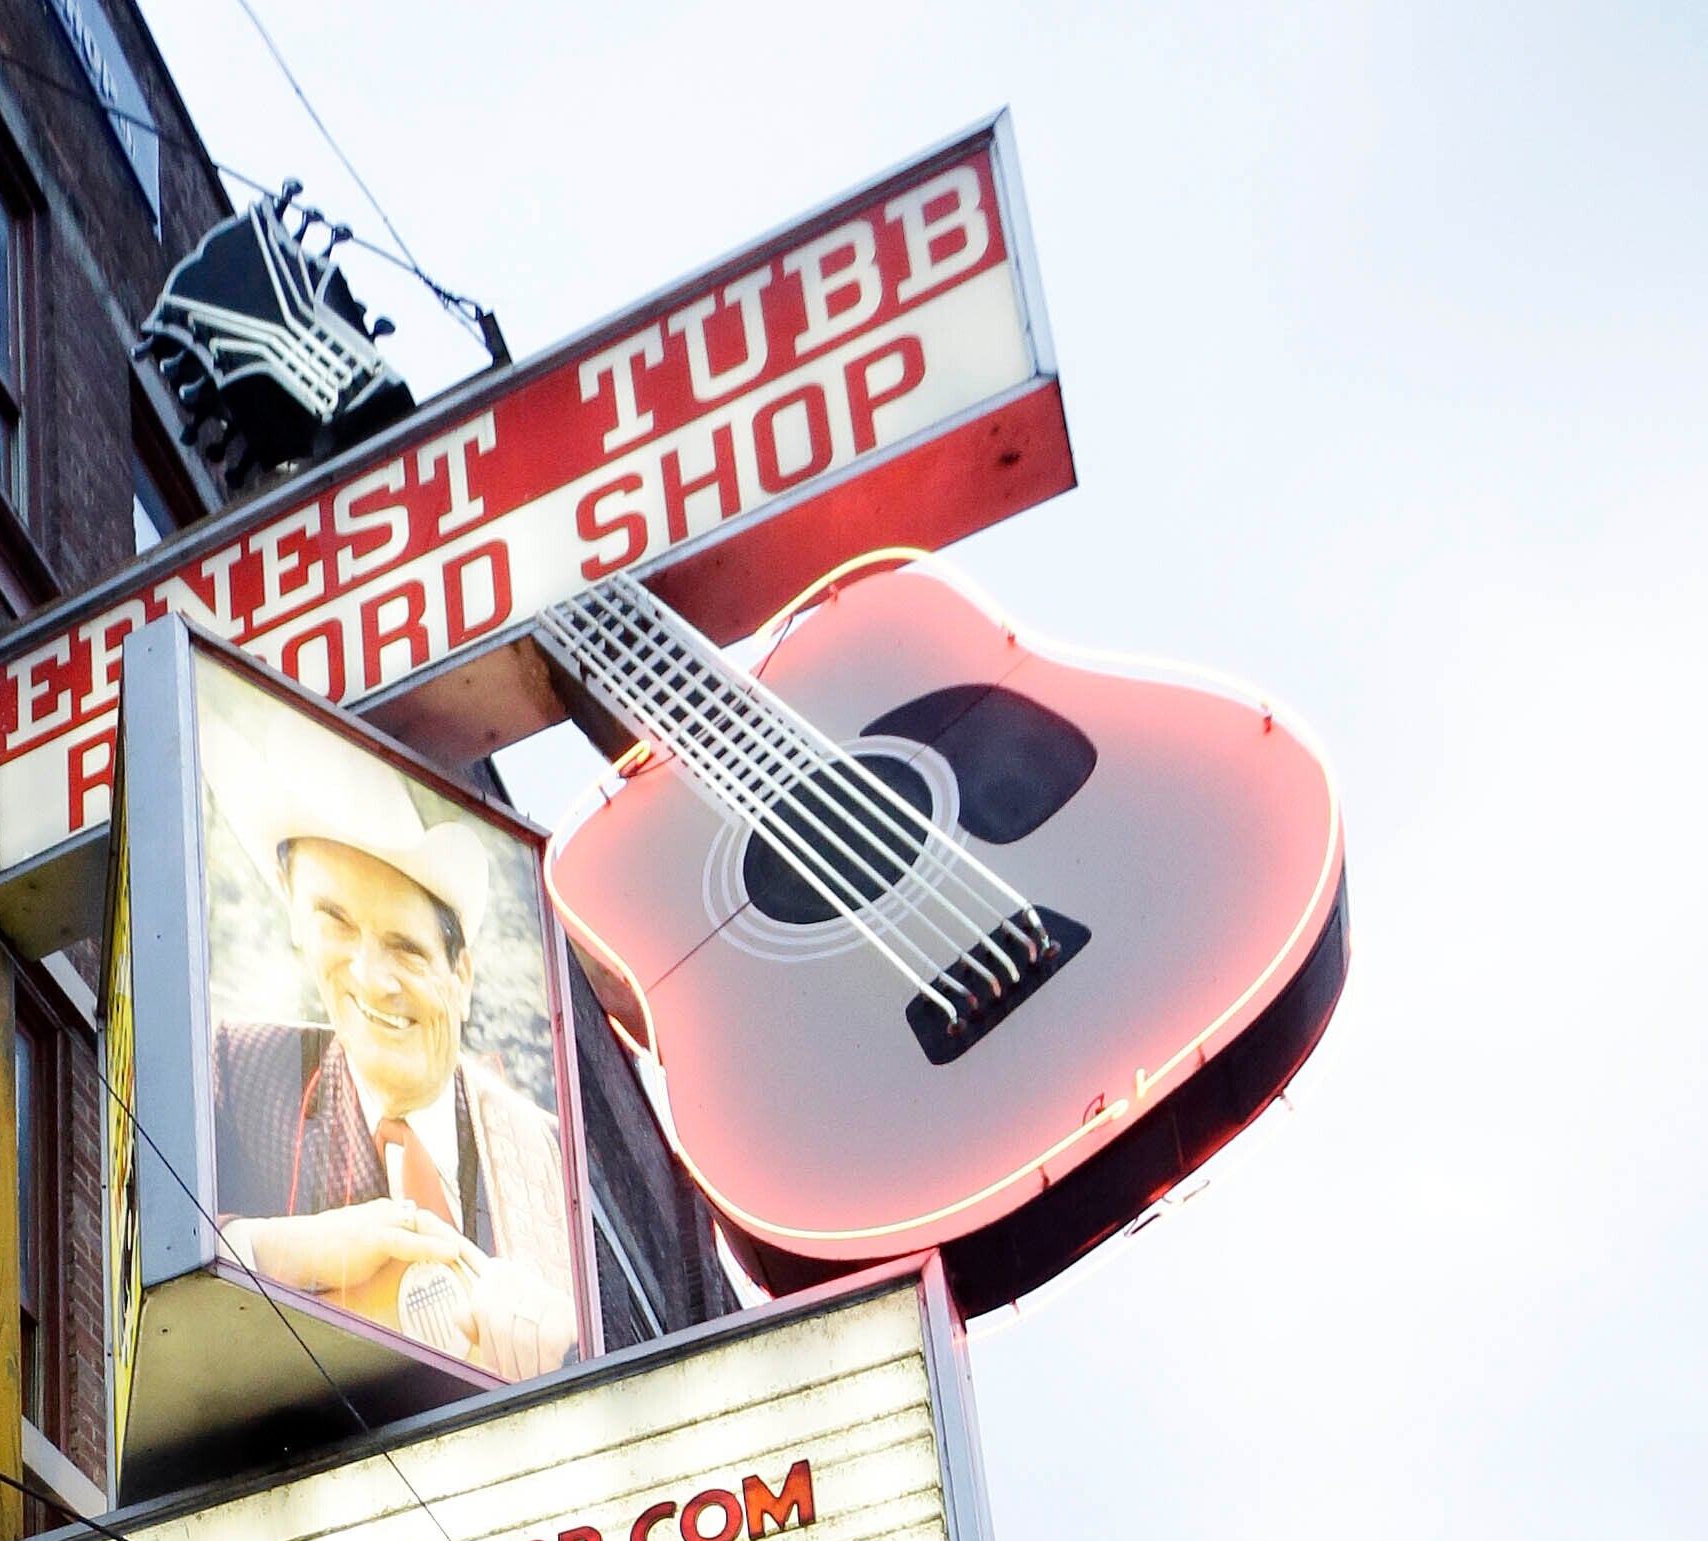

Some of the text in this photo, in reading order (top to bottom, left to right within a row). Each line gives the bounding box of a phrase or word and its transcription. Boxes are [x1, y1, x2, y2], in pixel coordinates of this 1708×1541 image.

[6, 167, 990, 751] ERNEST TUBB
[67, 334, 926, 833] RORD SHOP
